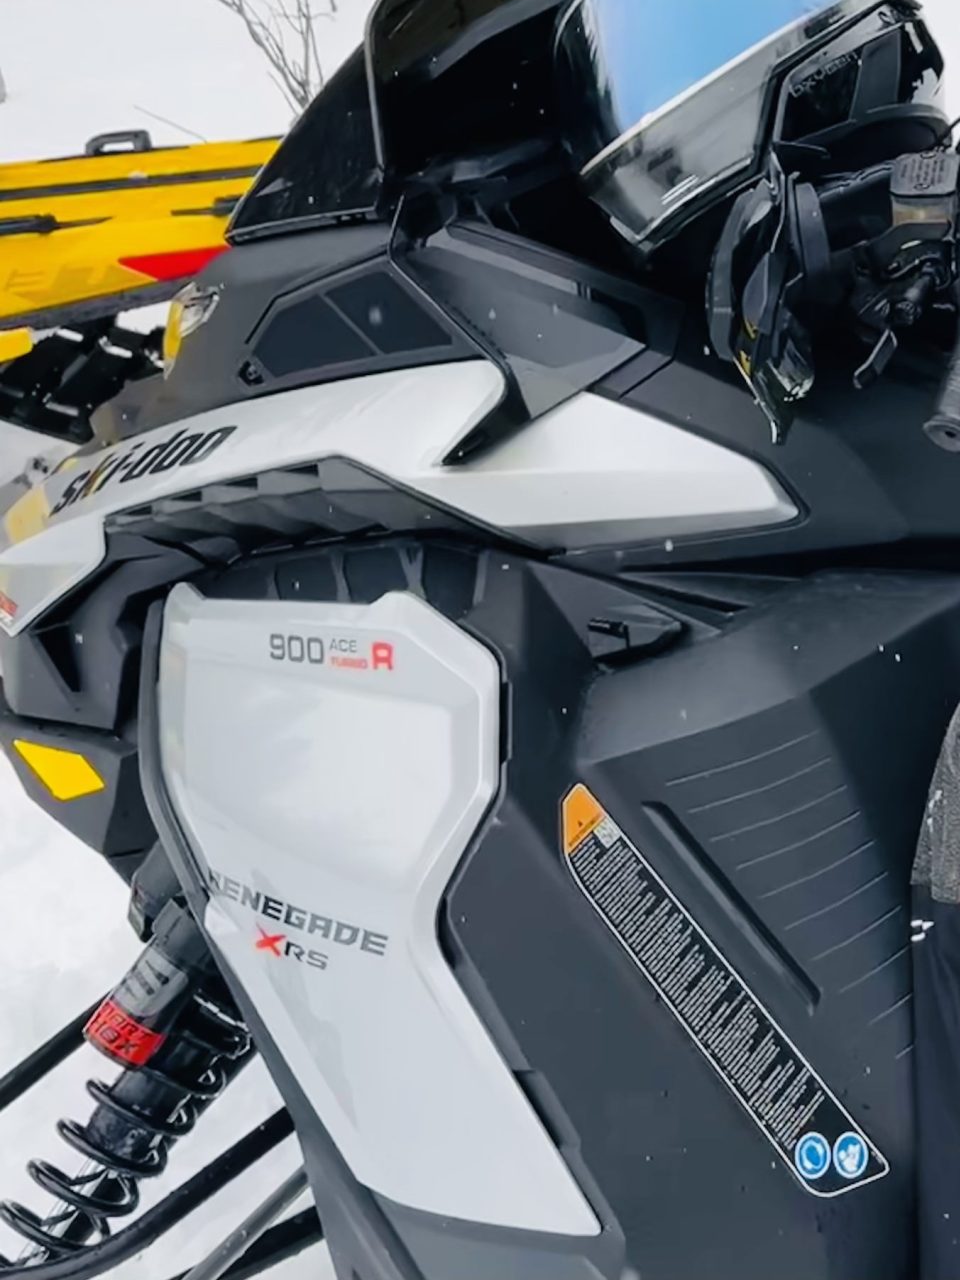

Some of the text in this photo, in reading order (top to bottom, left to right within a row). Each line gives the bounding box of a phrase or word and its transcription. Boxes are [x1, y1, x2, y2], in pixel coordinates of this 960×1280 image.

[269, 633, 394, 671] 900 ACE R
